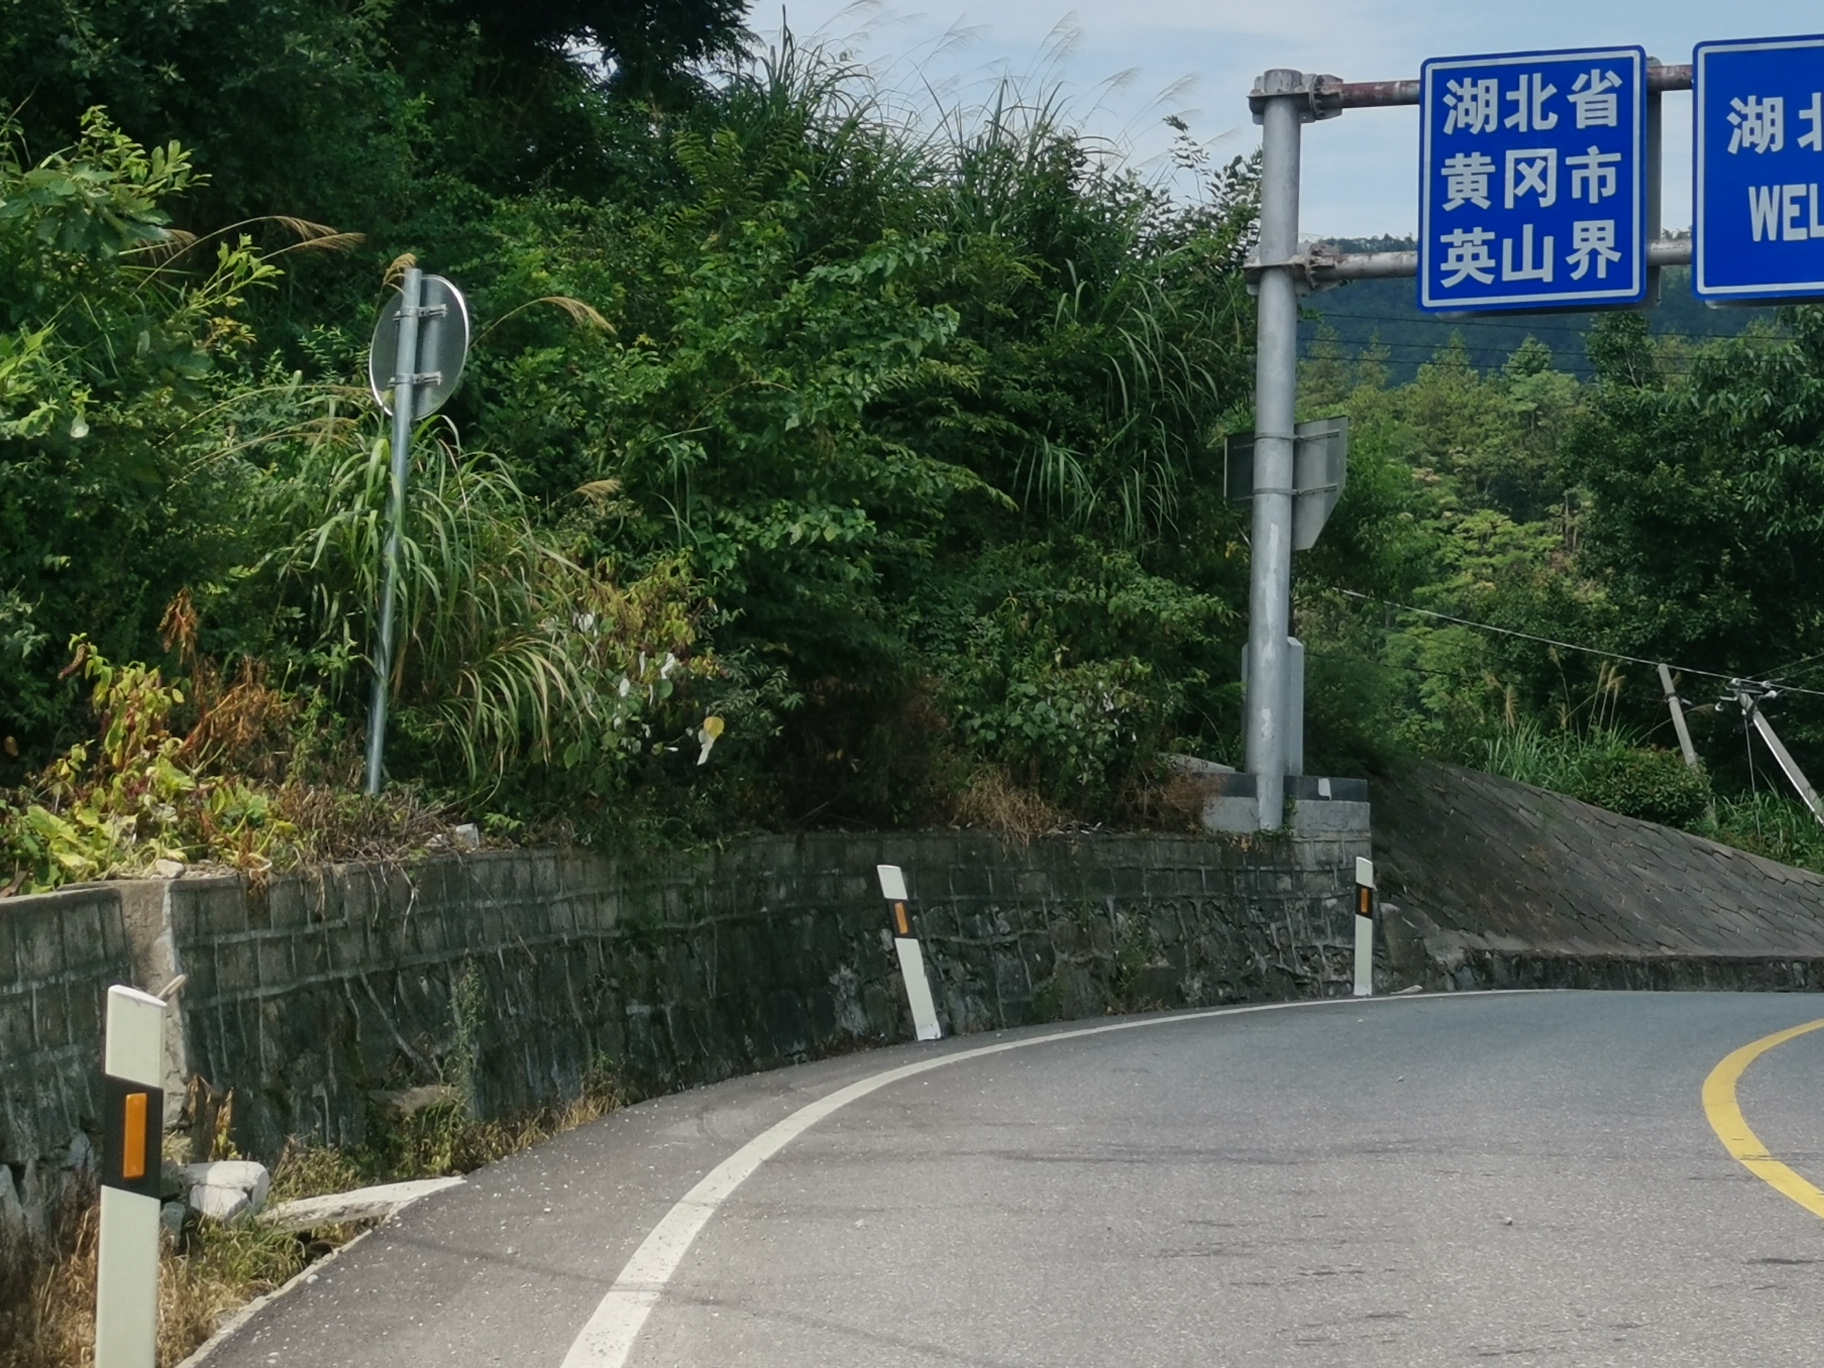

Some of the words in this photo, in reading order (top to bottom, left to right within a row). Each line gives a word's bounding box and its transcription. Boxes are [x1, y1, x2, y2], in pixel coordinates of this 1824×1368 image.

[1442, 69, 1624, 135] 湖北省
[1440, 145, 1622, 212] 黄冈市
[1440, 219, 1622, 289] 英山界
